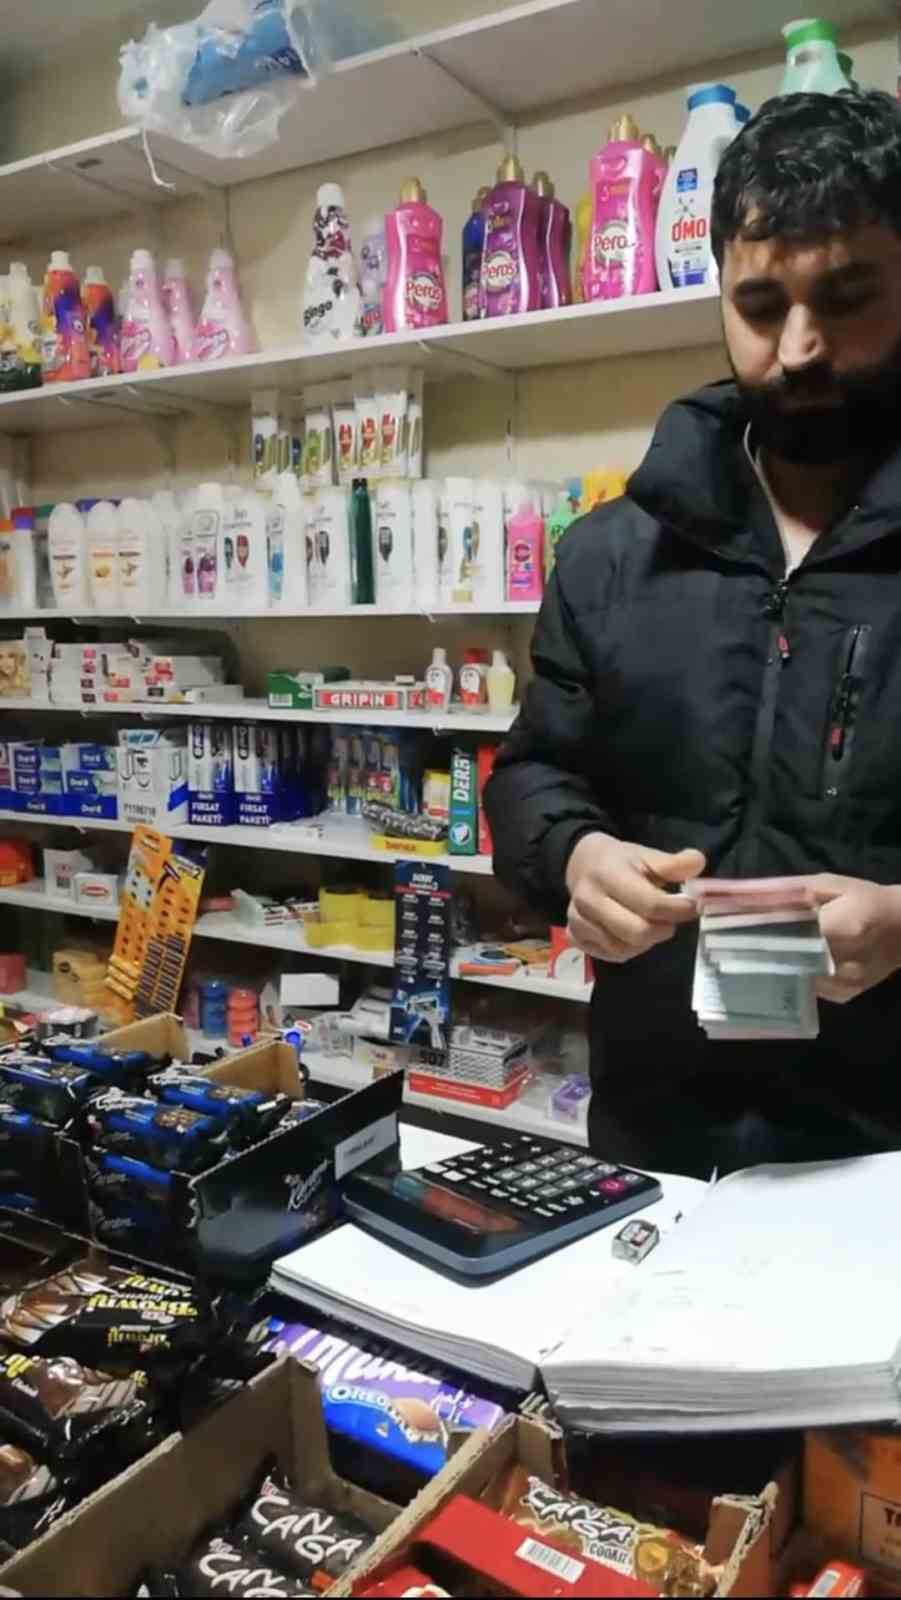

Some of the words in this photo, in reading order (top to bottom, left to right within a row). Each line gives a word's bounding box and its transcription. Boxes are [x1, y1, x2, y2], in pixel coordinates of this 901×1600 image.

[671, 217, 706, 241] OMO
[594, 235, 637, 251] Pero
[405, 281, 443, 301] Peros
[452, 746, 471, 801] DERBY
[191, 802, 220, 811] FIRSAT
[239, 803, 268, 813] FIRSAT
[330, 1385, 388, 1406] OREO
[251, 1495, 334, 1539] CAN
[294, 1533, 364, 1565] GA
[199, 1553, 286, 1592] CAN
